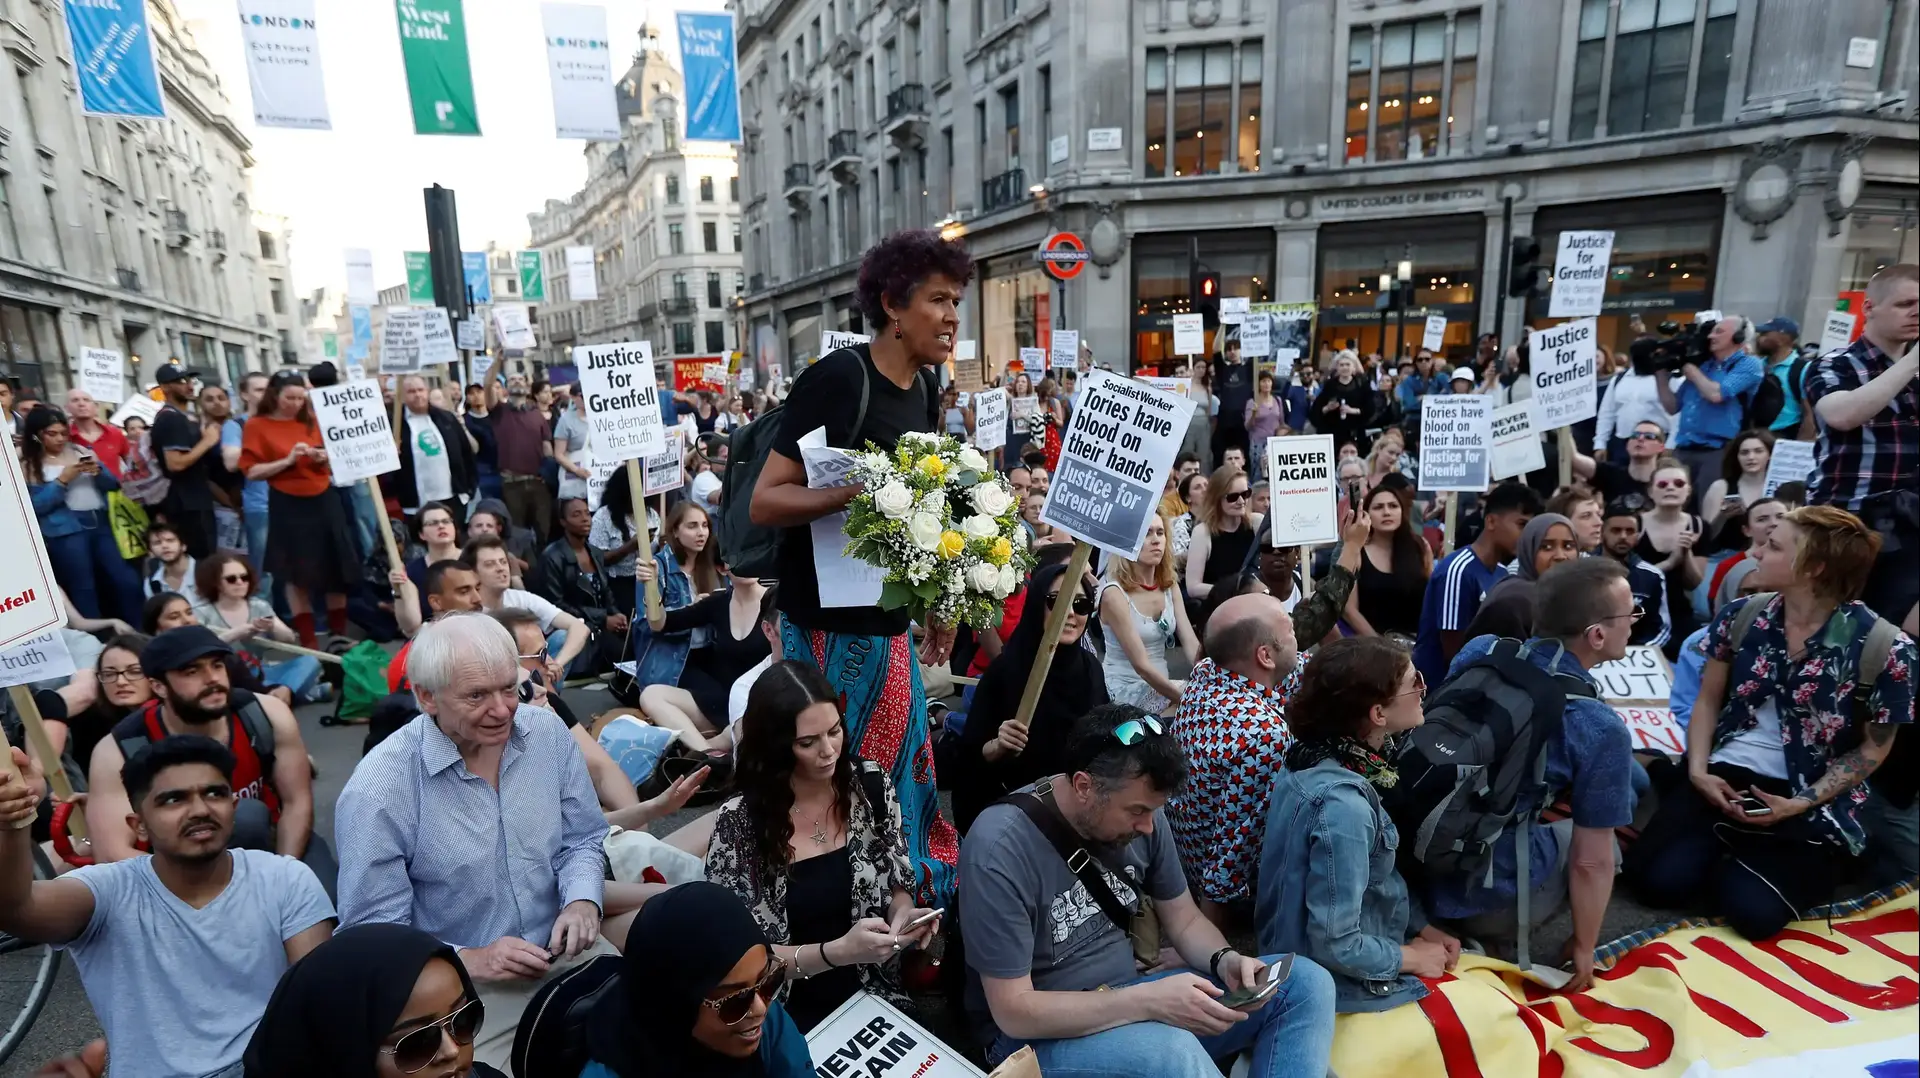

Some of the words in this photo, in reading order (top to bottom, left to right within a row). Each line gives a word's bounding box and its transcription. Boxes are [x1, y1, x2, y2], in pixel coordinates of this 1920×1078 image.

[1566, 235, 1606, 249] Justice
[1577, 251, 1594, 264] for
[1559, 266, 1605, 281] Grenfell
[1540, 326, 1589, 351] Justice
[588, 347, 645, 370] Justice
[1555, 349, 1577, 366] for
[607, 370, 632, 389] for
[1536, 359, 1593, 389] Grenfell
[322, 386, 374, 407] Justice
[589, 386, 656, 413] Grenfell
[1537, 391, 1556, 405] We
[342, 406, 363, 420] for
[1083, 386, 1130, 421] Tories
[1133, 405, 1172, 437] have
[1425, 406, 1457, 418] Tories
[1461, 405, 1484, 418] have
[1491, 412, 1528, 429] NEVER
[1546, 406, 1562, 418] the
[327, 416, 387, 442] Grenfell
[594, 418, 615, 433] We
[617, 410, 658, 430] demand
[1424, 420, 1453, 432] blood
[1457, 422, 1470, 431] on
[1492, 421, 1530, 439] AGAIN
[608, 433, 626, 448] the
[628, 428, 652, 444] truth
[1074, 409, 1120, 443] blood
[1121, 432, 1142, 453] on
[1424, 433, 1449, 446] their
[1453, 433, 1482, 446] hands
[1067, 432, 1104, 462] their
[1106, 447, 1154, 483] hands
[1278, 452, 1326, 466] NEVER
[1425, 449, 1462, 463] Justice
[1465, 449, 1481, 463] for
[1279, 467, 1327, 481] AGAIN
[1425, 463, 1466, 477] Grenfell
[1061, 460, 1112, 499] Justice
[1115, 482, 1142, 510] for
[1055, 482, 1113, 525] Grenfell
[2, 648, 48, 670] truth
